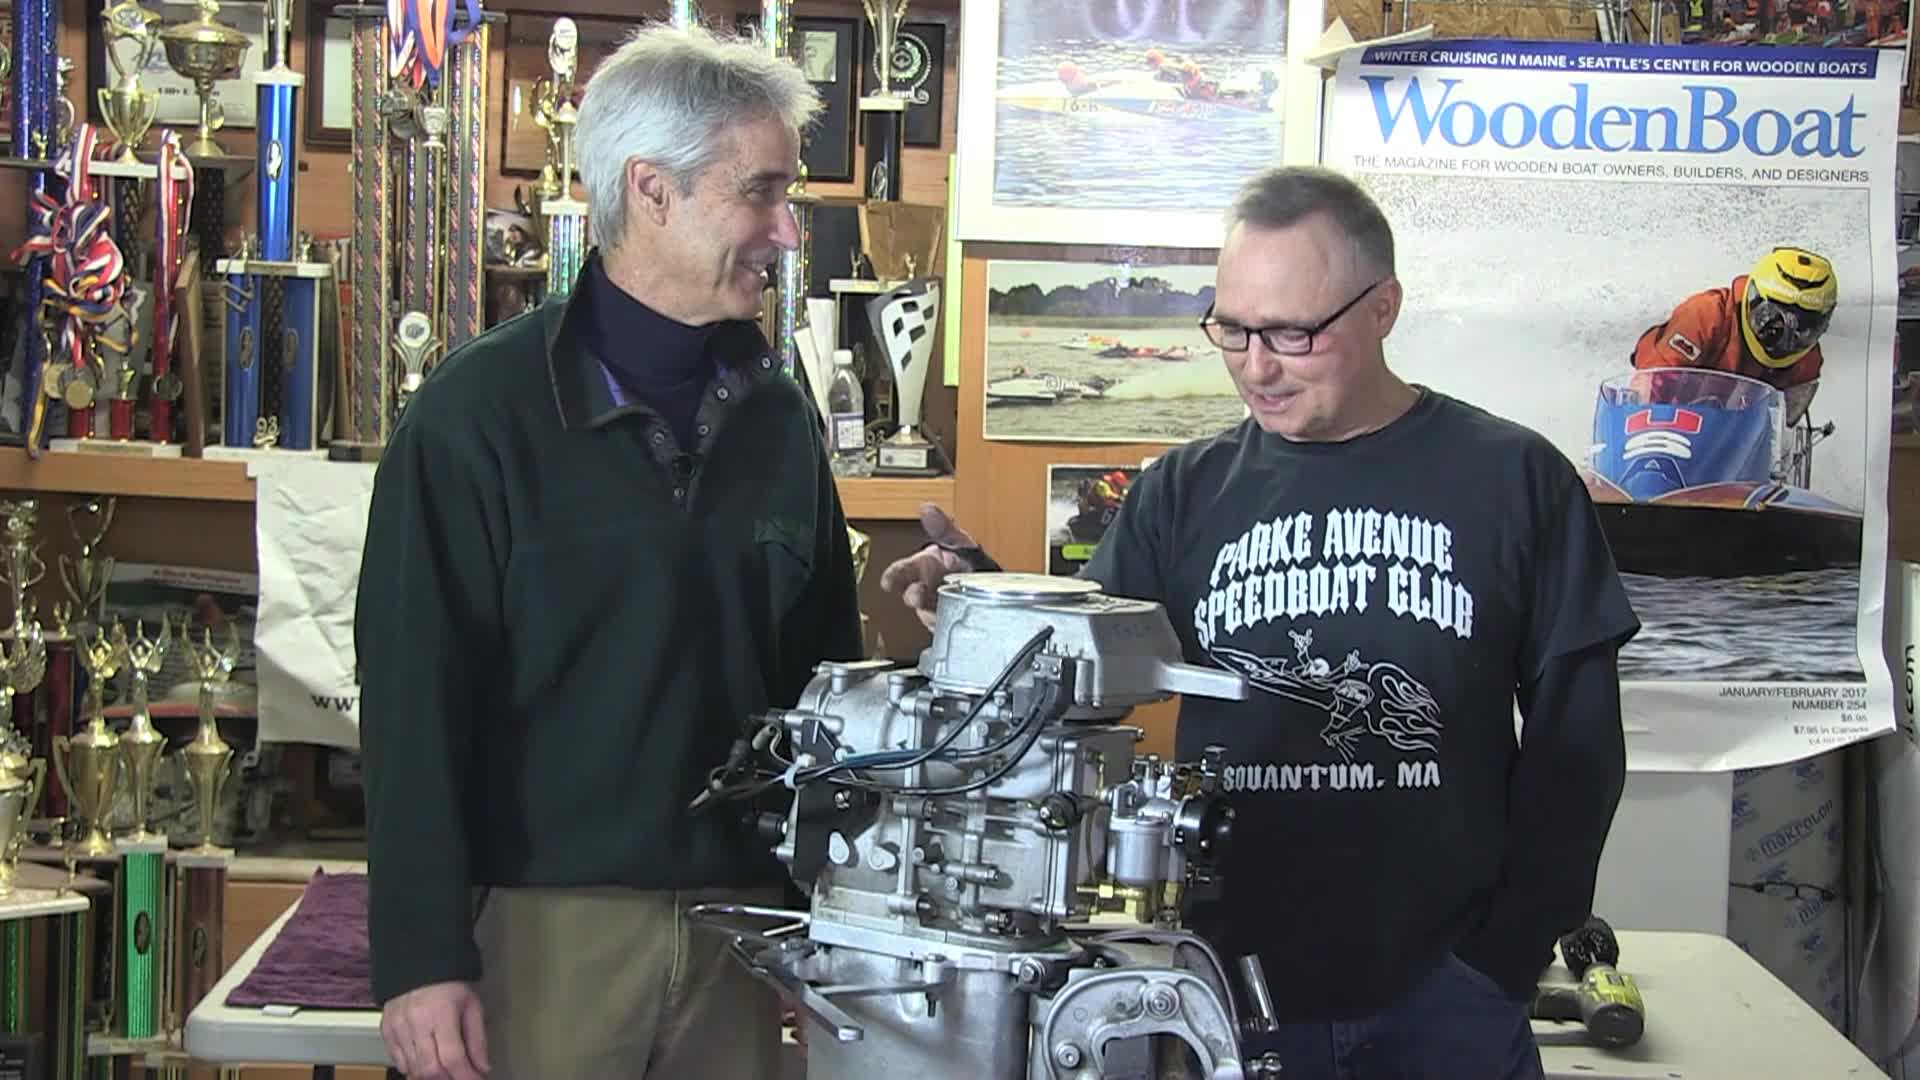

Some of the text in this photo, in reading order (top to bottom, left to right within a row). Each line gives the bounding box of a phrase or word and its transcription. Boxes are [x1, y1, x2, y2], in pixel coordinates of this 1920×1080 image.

[1374, 51, 1868, 75] WINTER CRUISING IN MAINE SEATTLE'S CENTER FOR WOODEN BOATS
[1360, 75, 1867, 159] WoodenBoat
[1354, 154, 1869, 182] THE MAGAZINE FOR WOODEN BOAT OWNERS, BUILDERS, AND DESIGNERS
[1209, 507, 1453, 588] PARKE AVENUE
[1193, 558, 1474, 651] SPEEDBOAT CLUB
[1720, 687, 1867, 698] JANUARY/FEBRUARY 2017
[1792, 700, 1844, 710] NUMBER
[1397, 761, 1441, 788] MA
